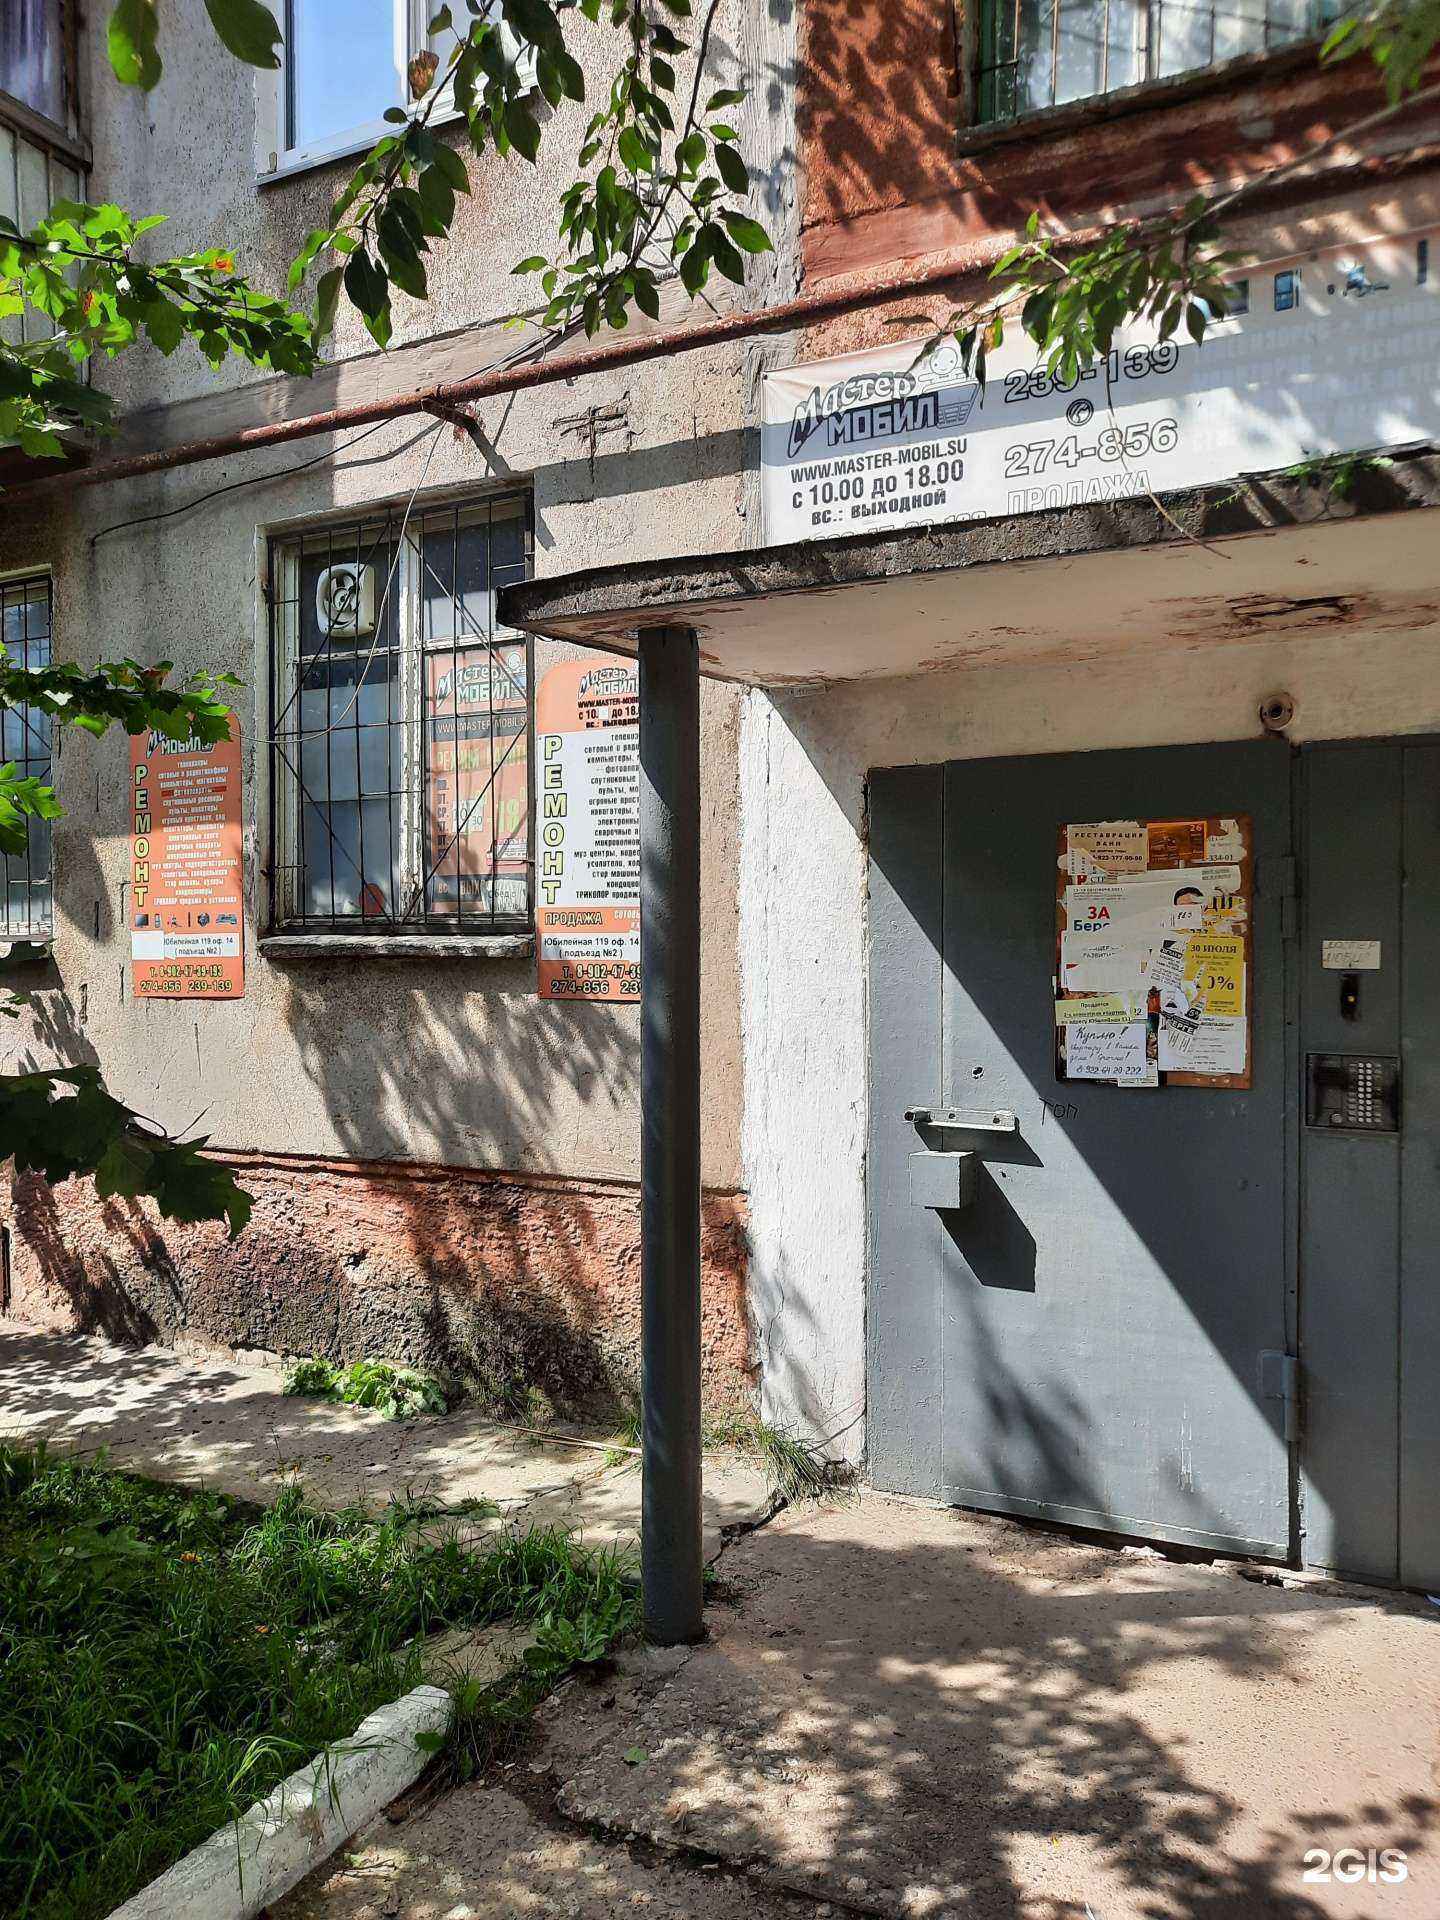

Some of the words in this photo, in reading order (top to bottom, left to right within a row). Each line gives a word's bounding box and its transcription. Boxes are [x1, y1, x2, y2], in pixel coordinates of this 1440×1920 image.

[1004, 338, 1179, 403] 239-139
[788, 371, 917, 458] Мастер
[827, 391, 939, 446] МОБИЛ
[790, 438, 968, 483] WWW.MASTER-MOBIL.SU
[1005, 418, 1178, 478] 274-856
[809, 476, 864, 506] 10.00
[871, 475, 897, 499] до
[905, 459, 964, 489] 18.00
[1007, 470, 1153, 515] ПРОДАЖА
[577, 668, 628, 699] Мастер
[593, 679, 637, 696] МОБИЛ
[133, 765, 152, 907] РЕМОНТ
[542, 735, 568, 904] РЕМОНТ
[545, 912, 603, 927] ПРОДАЖА
[1088, 905, 1110, 919] ЗА
[544, 937, 592, 946] Юбилейная
[596, 937, 608, 946] 119
[140, 981, 181, 993] 274-856
[188, 979, 233, 992] 239-139
[551, 980, 610, 994] 274-856
